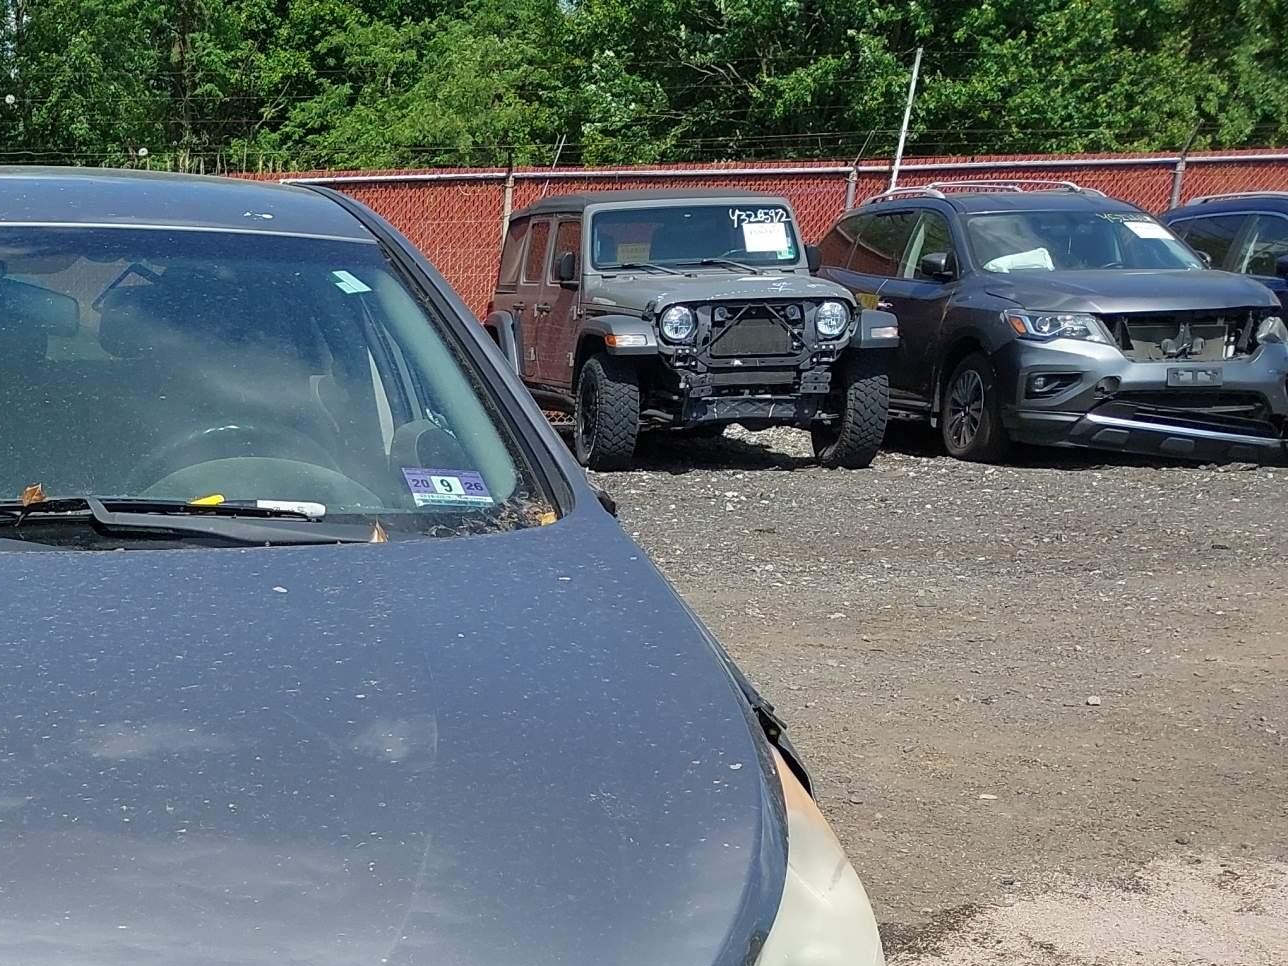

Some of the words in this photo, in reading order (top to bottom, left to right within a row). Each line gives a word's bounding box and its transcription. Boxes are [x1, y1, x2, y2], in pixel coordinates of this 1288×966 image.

[412, 479, 430, 488] 20
[440, 479, 453, 492] 9
[464, 481, 484, 491] 26
